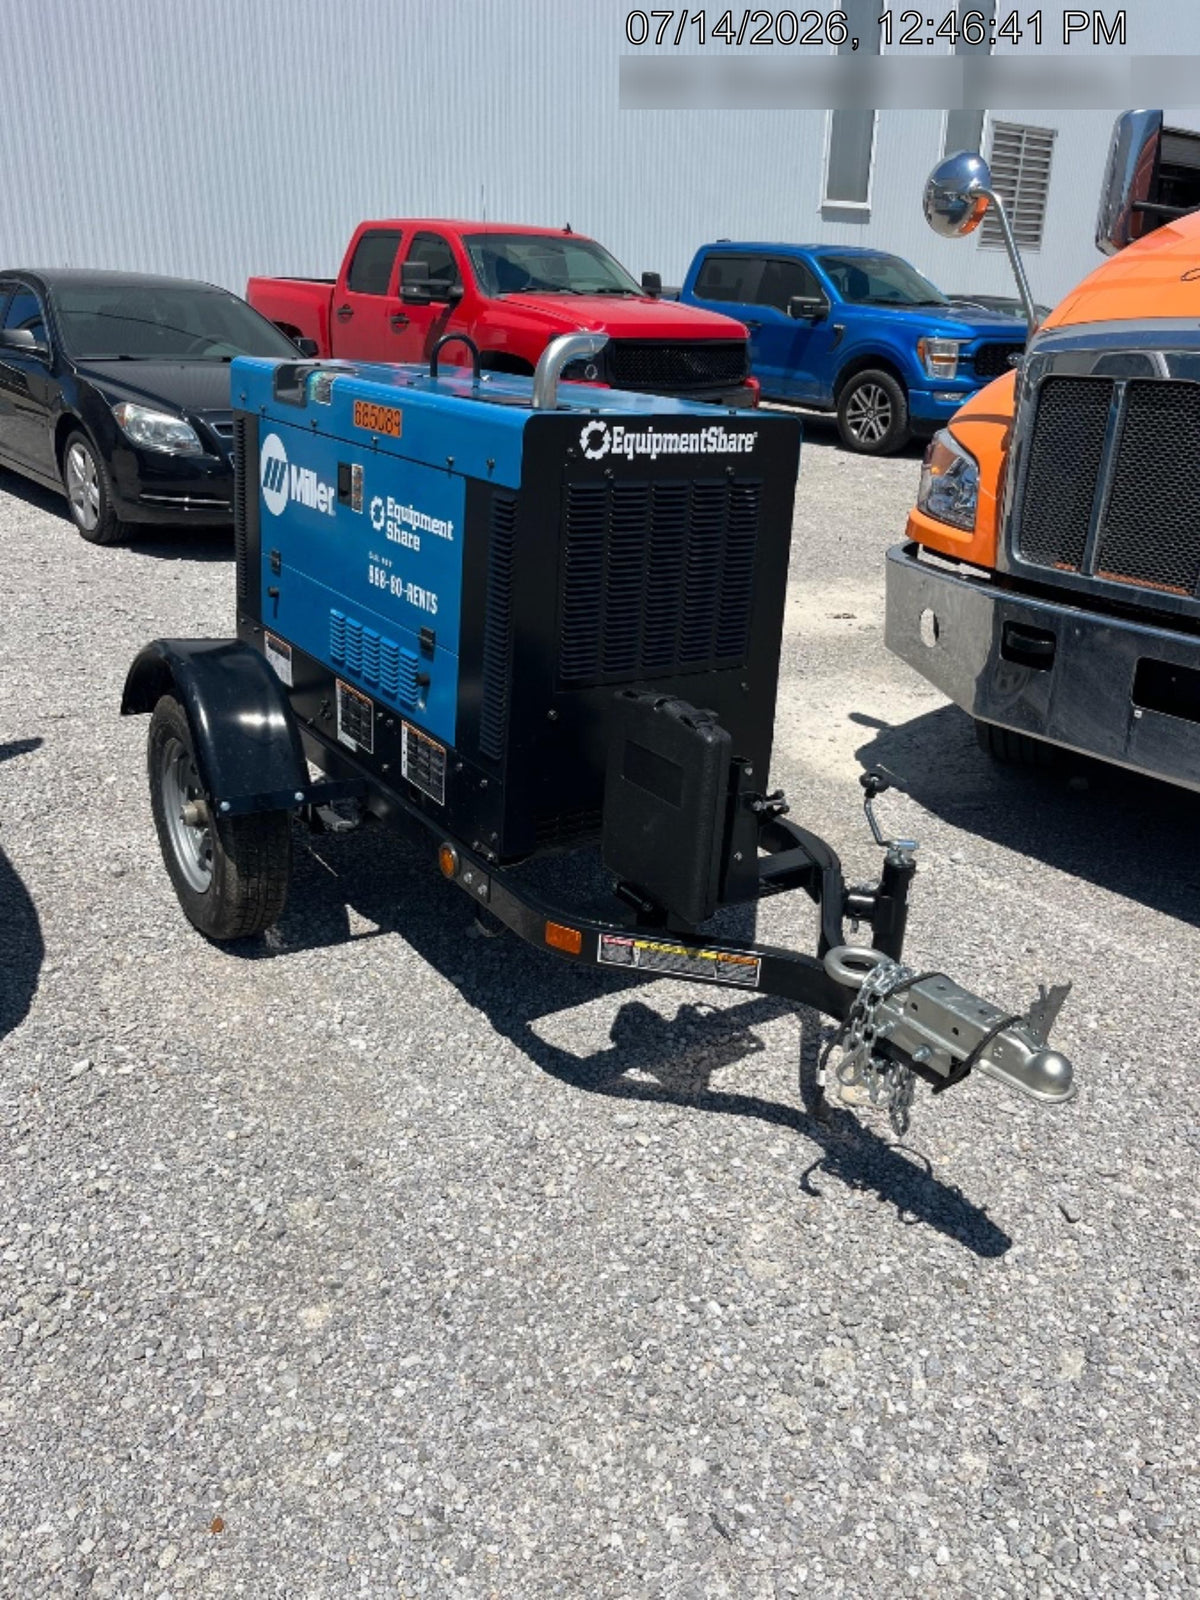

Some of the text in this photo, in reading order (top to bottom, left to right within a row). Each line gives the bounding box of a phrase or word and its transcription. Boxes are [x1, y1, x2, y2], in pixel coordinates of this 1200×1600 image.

[611, 426, 756, 460] EquipmentShare
[291, 464, 335, 516] Miller
[386, 496, 454, 541] Equipment
[386, 521, 420, 552] Share
